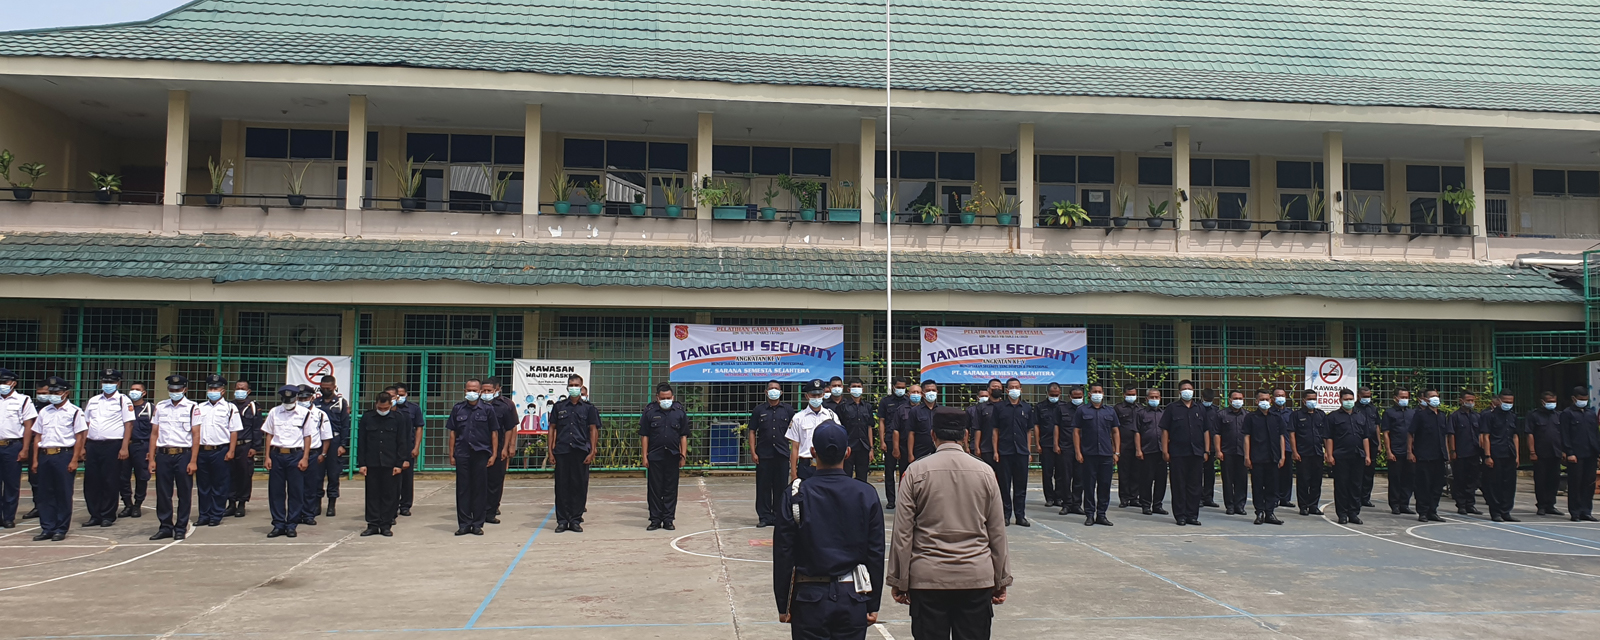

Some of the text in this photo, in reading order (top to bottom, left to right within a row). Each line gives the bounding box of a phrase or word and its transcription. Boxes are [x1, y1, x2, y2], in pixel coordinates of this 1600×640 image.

[677, 340, 836, 361] TANGGUH SECURITY
[927, 344, 1080, 364] TANGGUH SECURITY
